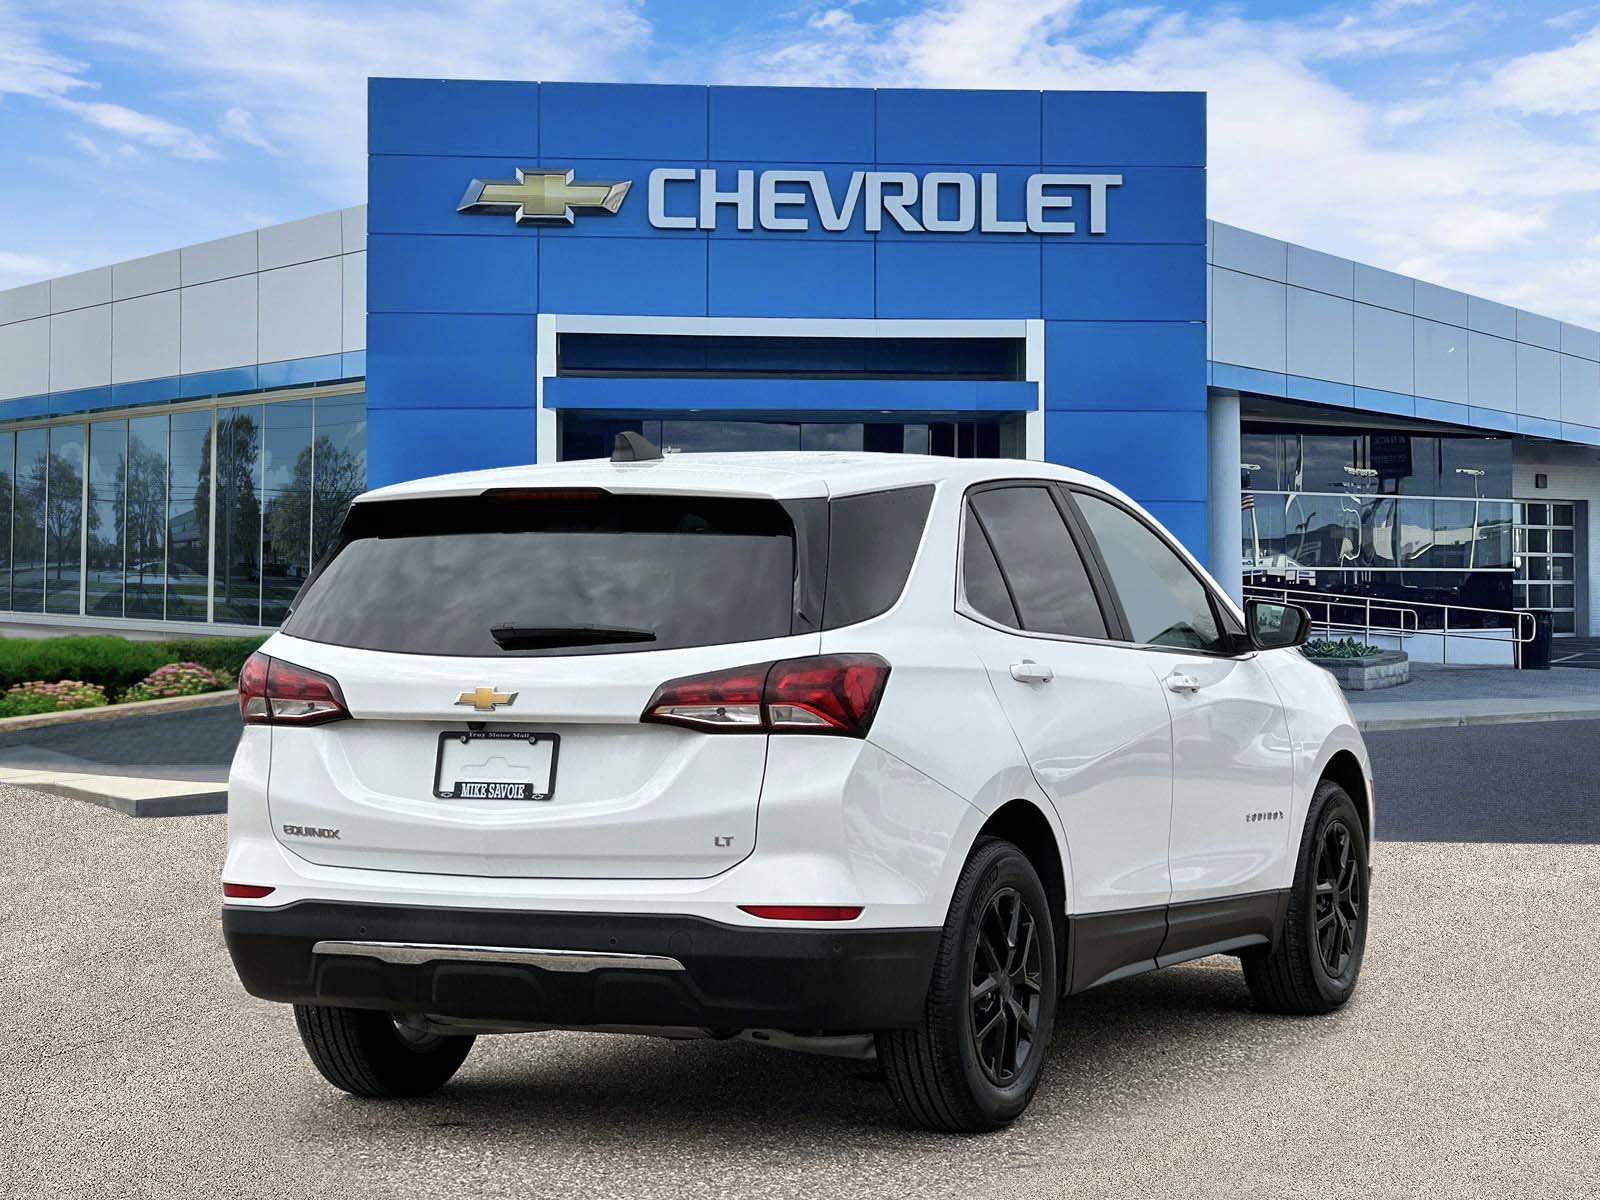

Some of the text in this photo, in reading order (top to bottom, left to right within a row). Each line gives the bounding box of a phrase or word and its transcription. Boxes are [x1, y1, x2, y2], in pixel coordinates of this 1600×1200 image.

[648, 168, 1123, 234] CHEVROLET
[460, 783, 525, 799] MIKE SAVOIE
[283, 824, 341, 840] EQUINOX
[714, 836, 735, 847] LT
